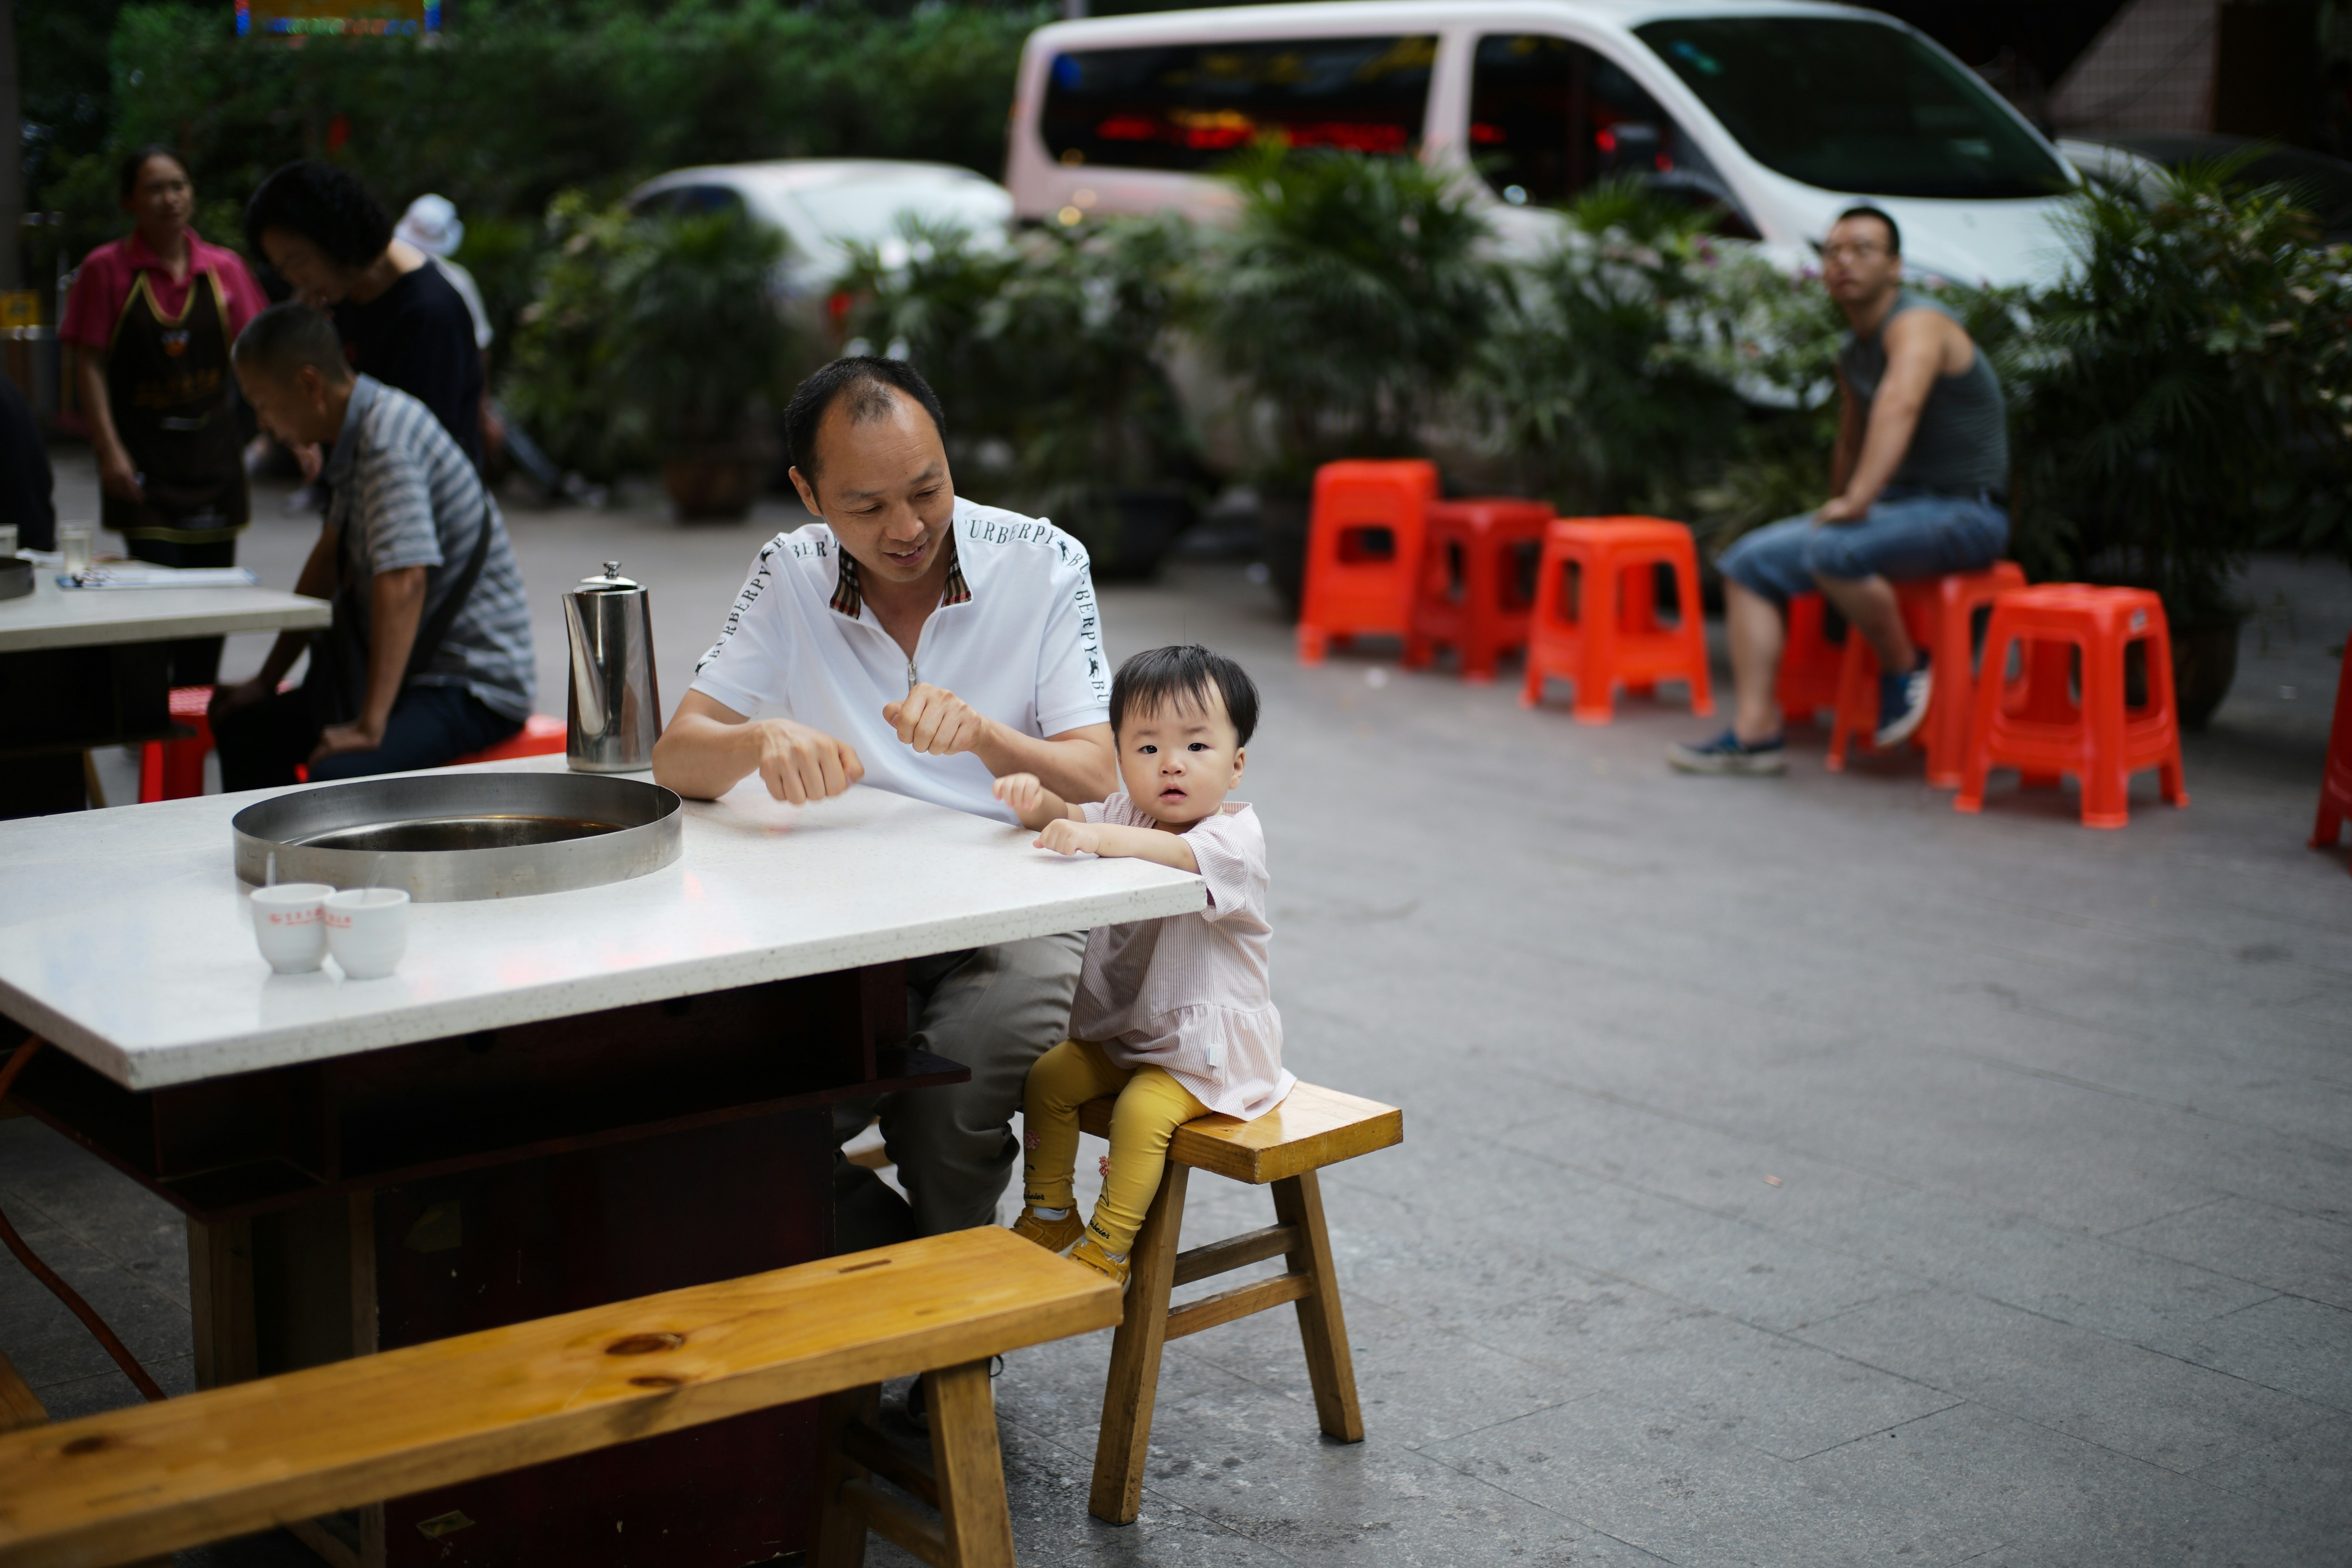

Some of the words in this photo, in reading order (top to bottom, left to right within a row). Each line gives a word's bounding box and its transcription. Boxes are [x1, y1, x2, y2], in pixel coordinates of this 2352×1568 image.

[965, 518, 1058, 545] URBERPY
[709, 566, 771, 658] BURBERPY
[1066, 553, 1097, 655] BUBERPY
